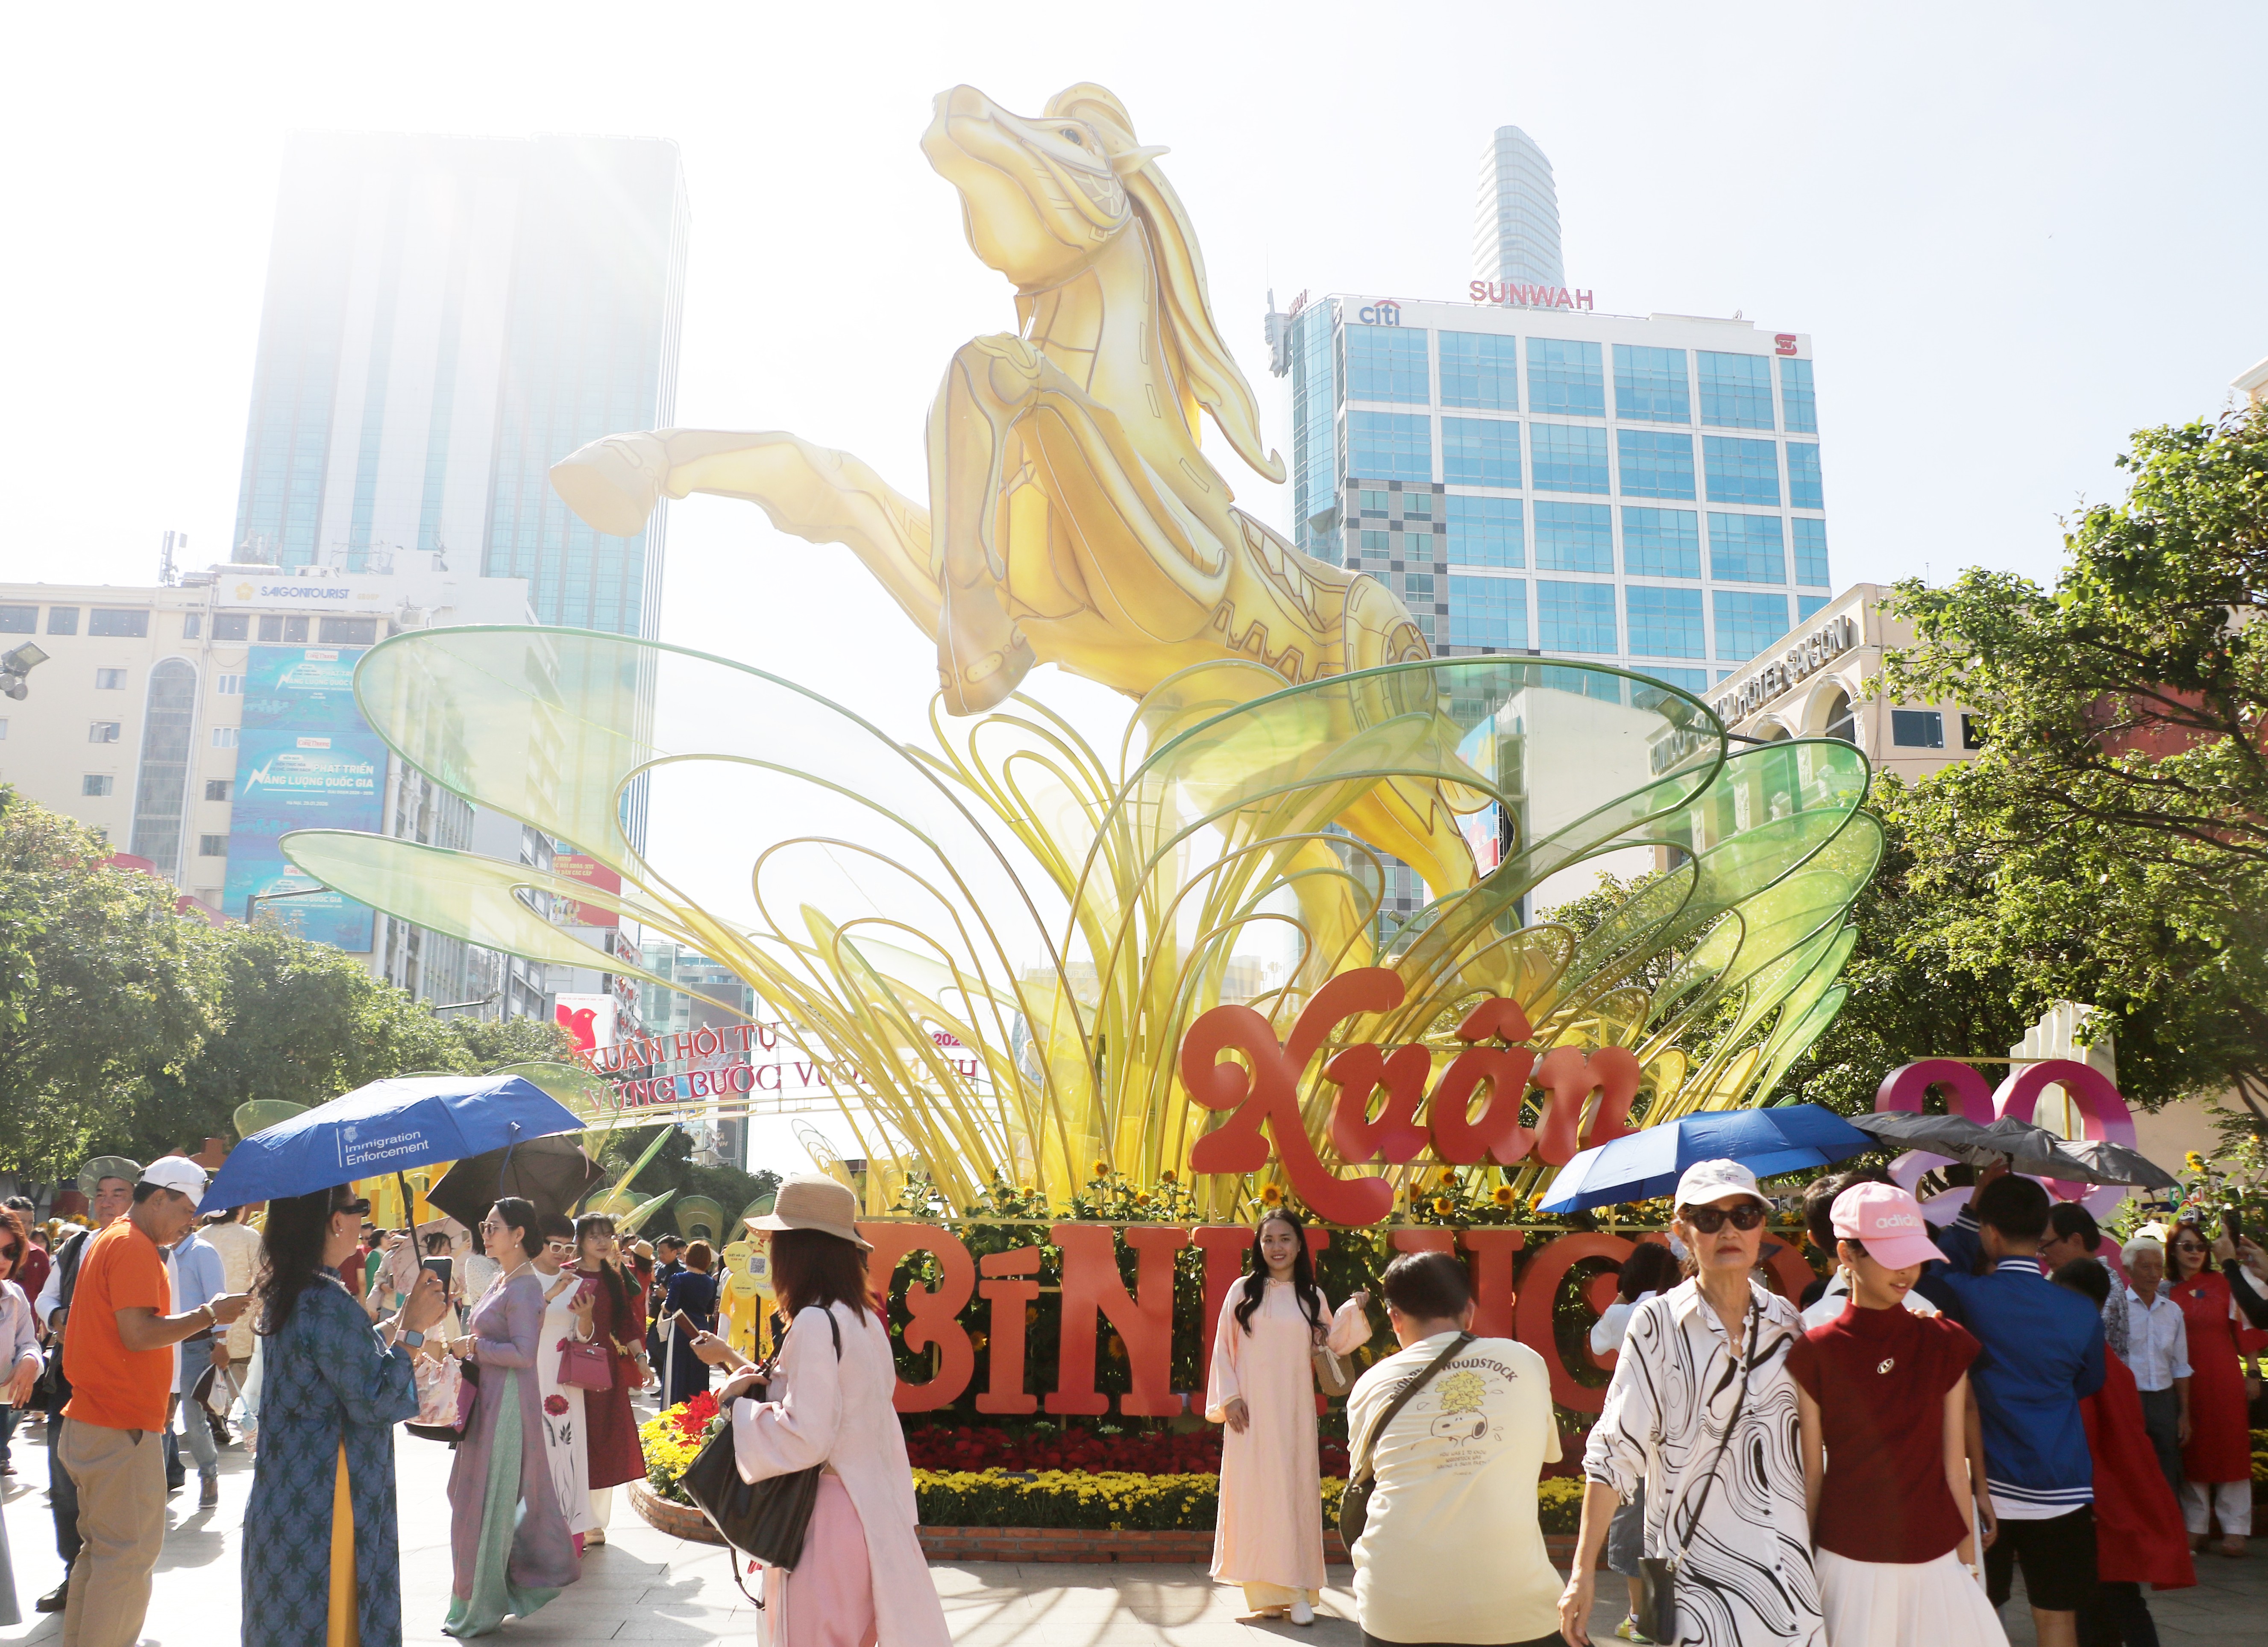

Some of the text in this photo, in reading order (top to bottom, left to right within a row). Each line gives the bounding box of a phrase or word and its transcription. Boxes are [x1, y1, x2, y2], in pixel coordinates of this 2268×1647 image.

[1470, 280, 1593, 310] SUNWAH
[1359, 301, 1401, 326] citi
[261, 586, 350, 599] SAIGONTOURIST
[1737, 661, 1782, 716] HOTEL
[1786, 615, 1848, 684] SAIGON
[343, 762, 374, 774] TRIỂN
[288, 775, 323, 788] LƯỢNG
[326, 775, 354, 787] QUỐC
[355, 778, 374, 787] GIA
[577, 1022, 776, 1077] XUÂN HỘI TỤ
[933, 1033, 964, 1046] 202
[582, 1075, 677, 1114] VỮNG
[687, 1061, 781, 1099] BƯỚC
[1177, 967, 1641, 1225] Xuân
[345, 1131, 421, 1153] Immigration
[346, 1139, 429, 1166] Enforcement
[1875, 1214, 1922, 1229] adida
[1441, 1358, 1518, 1383] WOODSTOCK
